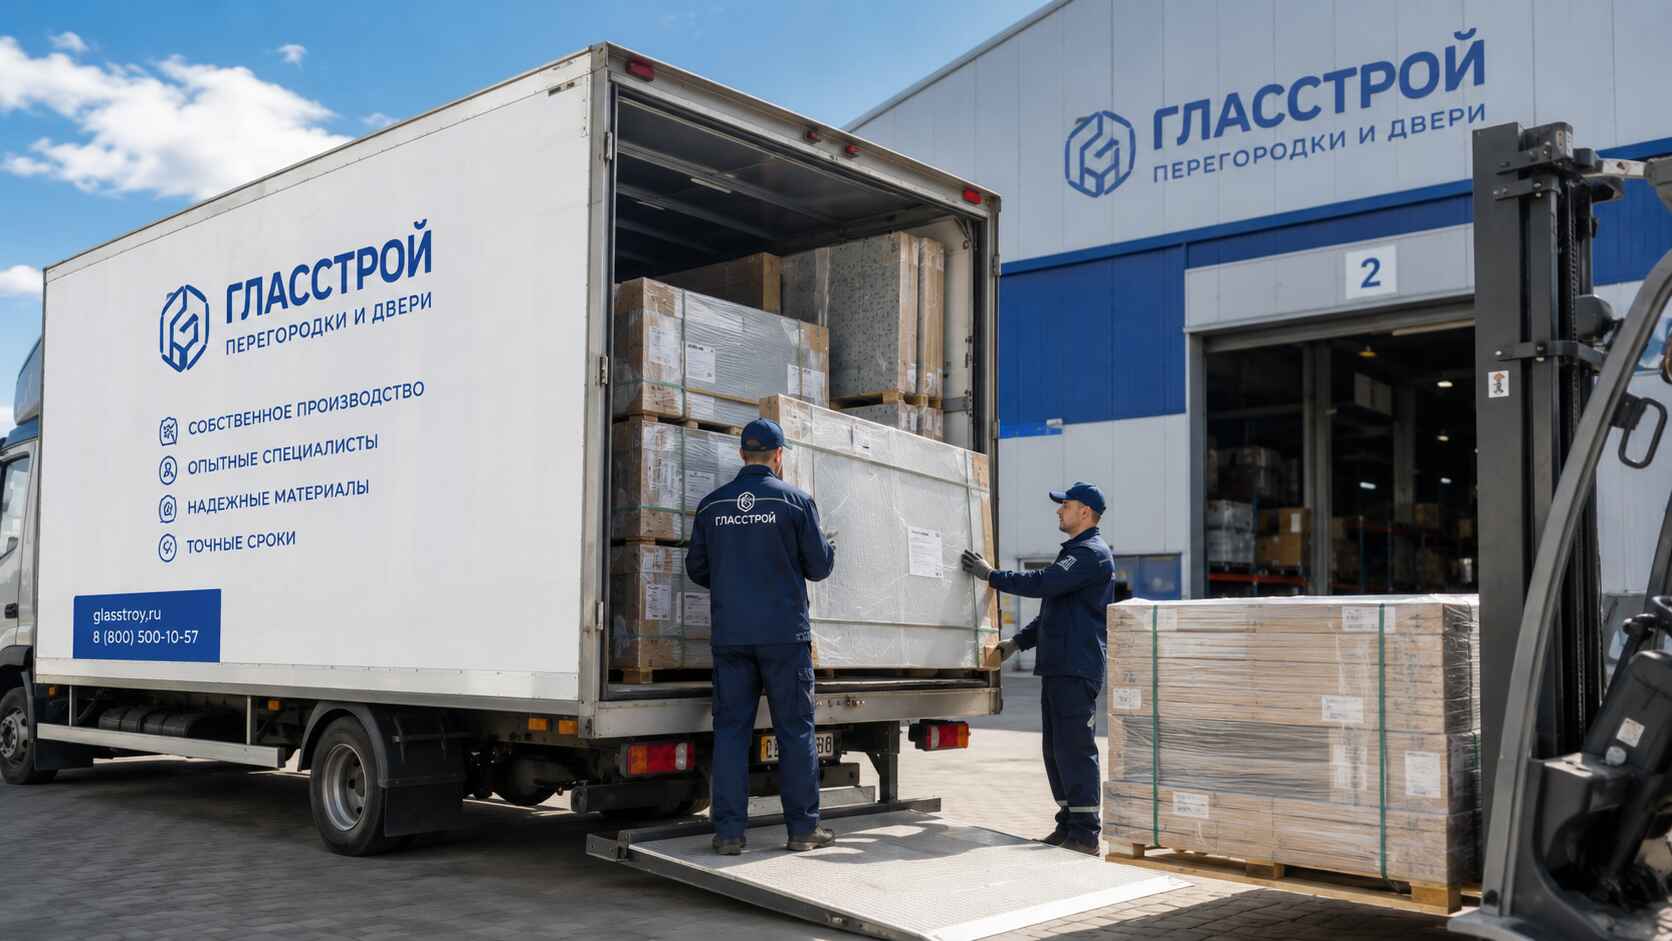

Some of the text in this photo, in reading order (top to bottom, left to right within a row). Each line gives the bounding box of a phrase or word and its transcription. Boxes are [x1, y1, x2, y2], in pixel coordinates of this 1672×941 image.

[1153, 27, 1486, 150] ГЛАССТРОЙ
[1153, 103, 1486, 183] ПЕРЕГОРОДКИ И ДВЕРИ
[226, 218, 432, 324] ГЛАССТРОЙ
[1360, 257, 1382, 289] 2
[226, 292, 432, 355] ПЕРЕГОРОДКИ И ДВЕРИ
[188, 381, 425, 435] СОБСТВЕННОЕ ПРОИЗВОДСТВО
[188, 434, 378, 475] ОПЫТНЫЕ СПЕЦИАЛИСТЫ
[187, 480, 369, 514] НАДЕЖНЫЕ МАТЕРИАЛЫ
[715, 511, 776, 526] ГЛАССТРОЙ
[187, 531, 296, 554] ТОЧНЫЕ СРОКИ
[92, 630, 199, 646] 8 (800) 500-10-57
